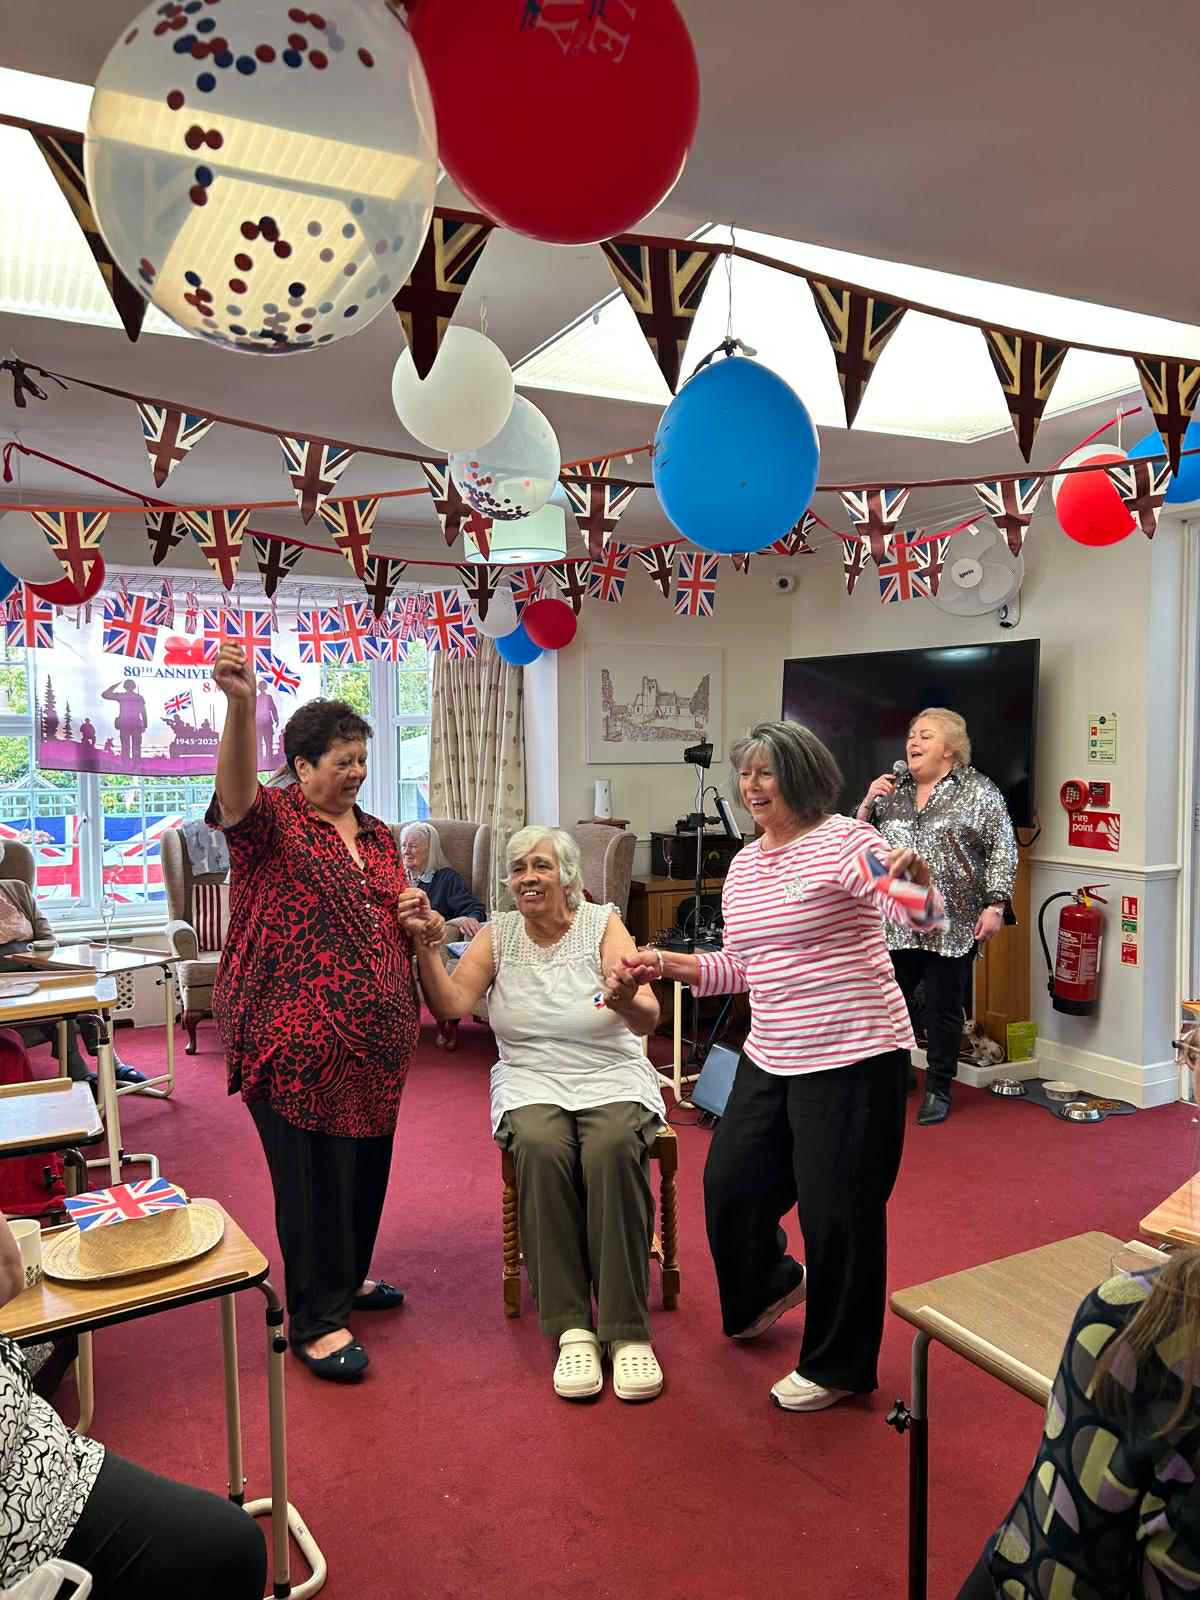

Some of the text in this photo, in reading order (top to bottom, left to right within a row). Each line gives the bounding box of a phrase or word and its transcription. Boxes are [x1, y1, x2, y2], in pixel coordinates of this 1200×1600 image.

[202, 681, 211, 693] 8
[1072, 812, 1088, 823] Fire
[1072, 823, 1094, 832] point
